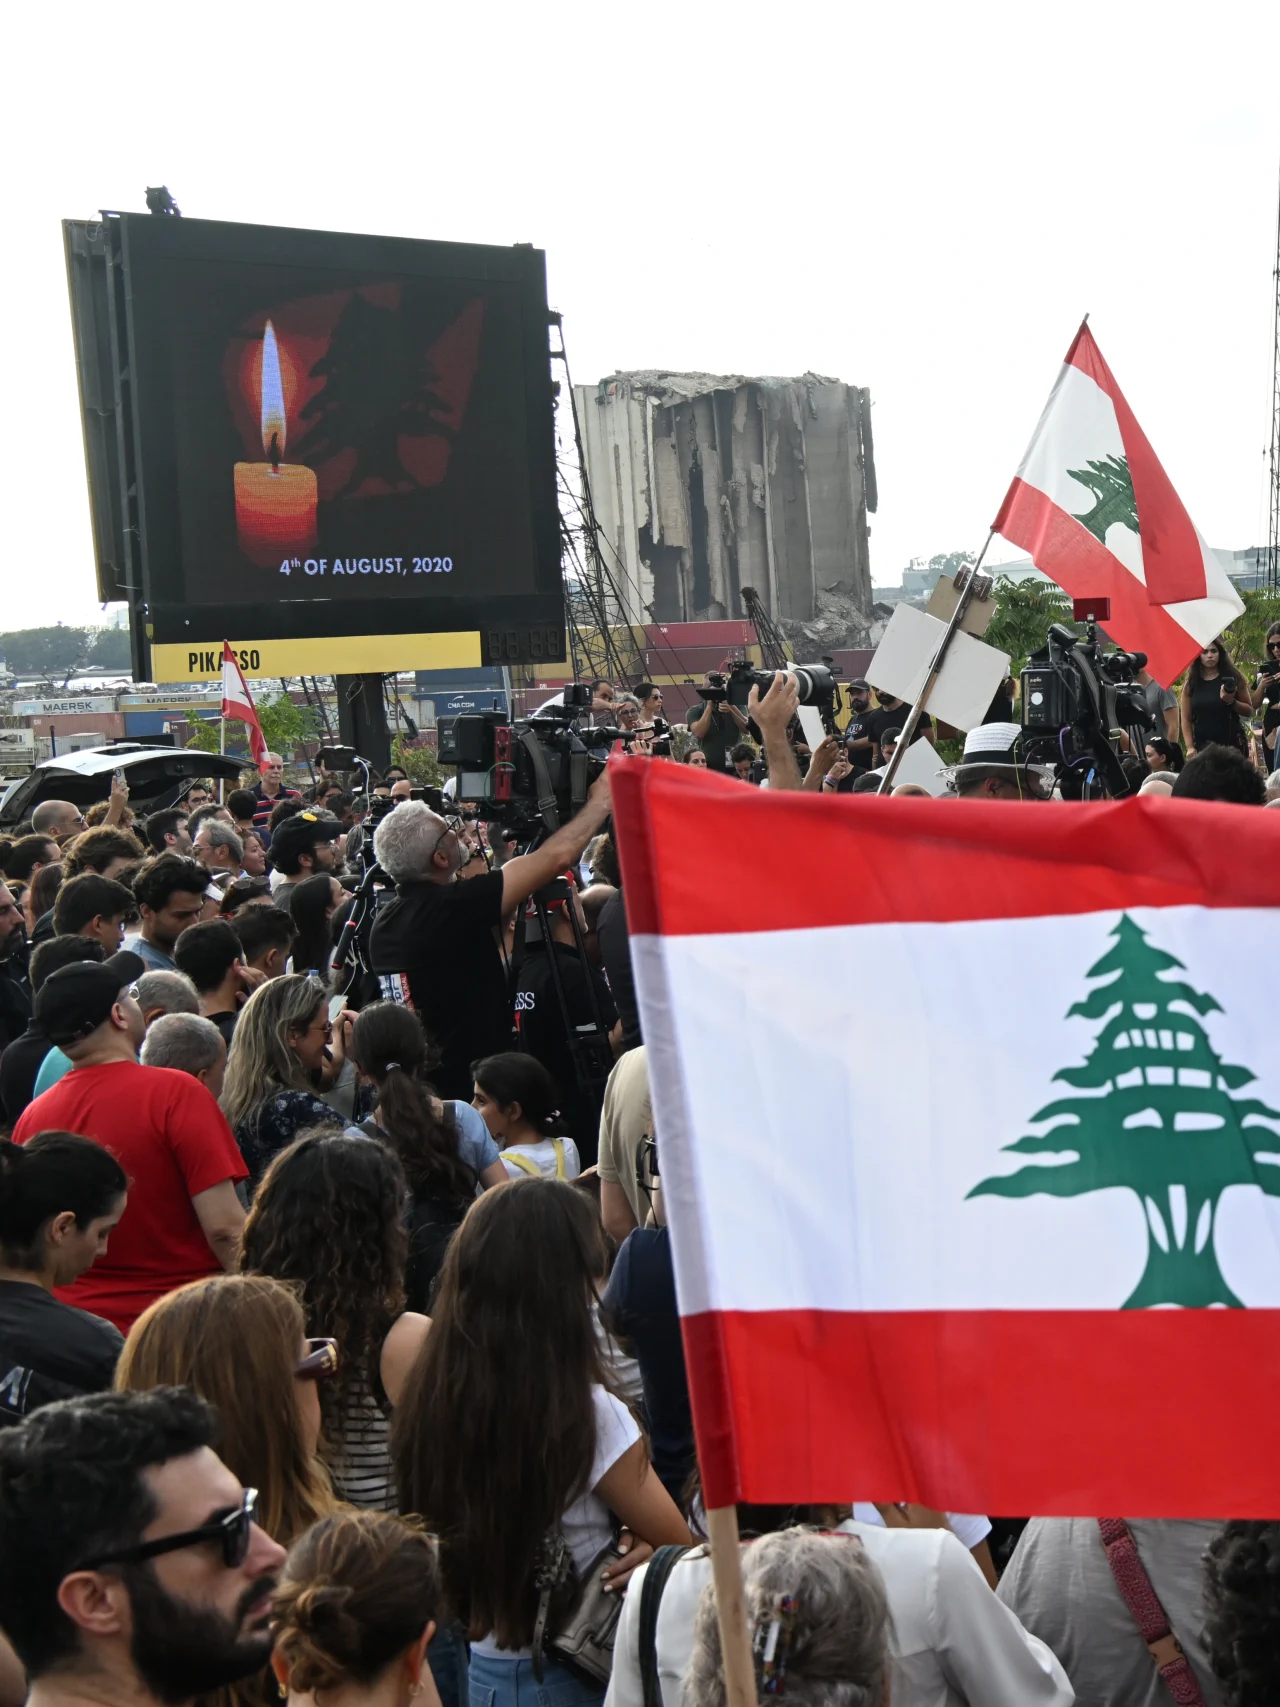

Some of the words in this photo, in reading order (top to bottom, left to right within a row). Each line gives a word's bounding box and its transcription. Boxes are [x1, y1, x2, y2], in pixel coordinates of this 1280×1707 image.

[279, 557, 301, 576] 4th
[304, 559, 328, 576] OF
[332, 558, 407, 576] AUGUST,
[412, 557, 453, 573] 2020
[188, 650, 260, 673] PIKASO
[42, 701, 93, 712] MAERSK
